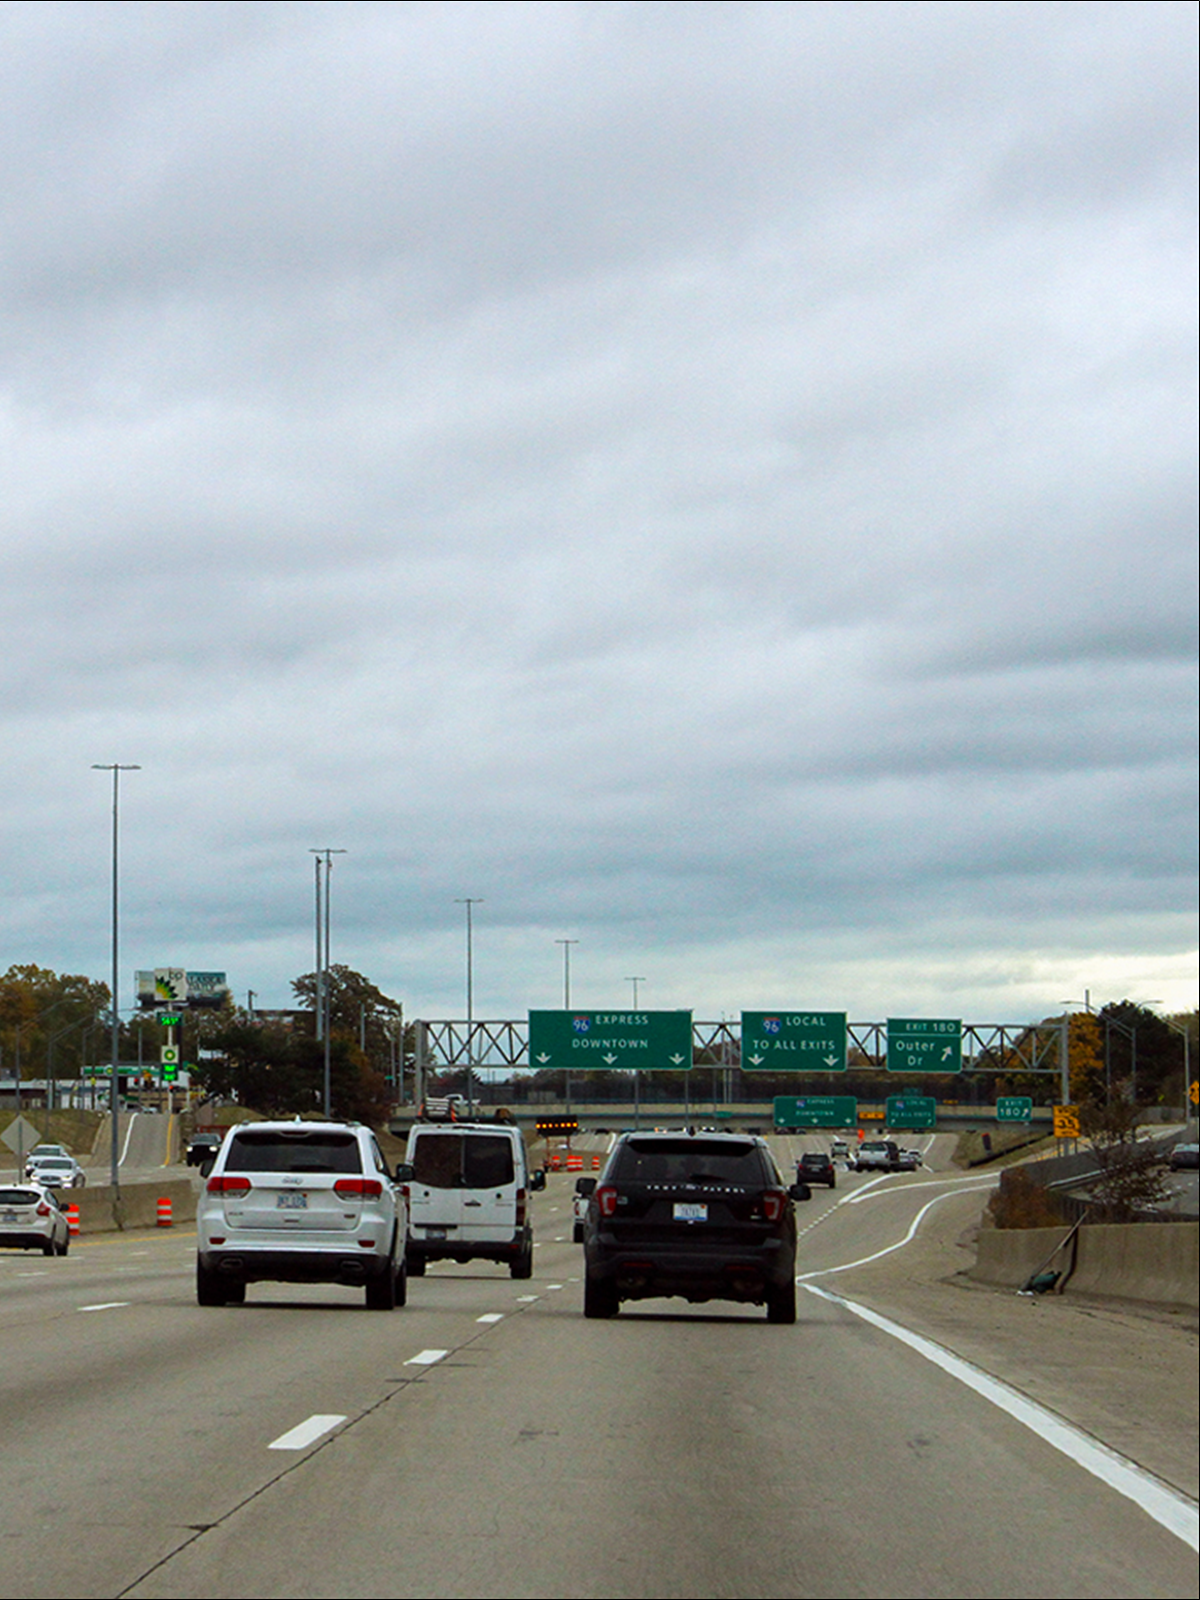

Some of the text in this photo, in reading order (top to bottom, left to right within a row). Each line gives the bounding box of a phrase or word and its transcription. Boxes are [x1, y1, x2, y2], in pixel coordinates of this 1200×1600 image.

[573, 1015, 648, 1031] 96 EXPRESS
[763, 1016, 826, 1033] 96 LOCAL
[906, 1022, 955, 1033] EXIT 180
[572, 1038, 649, 1049] DOWNTOWN
[753, 1040, 835, 1050] TO ALL EXITS
[895, 1040, 935, 1052] Outer
[907, 1055, 923, 1067] Dr
